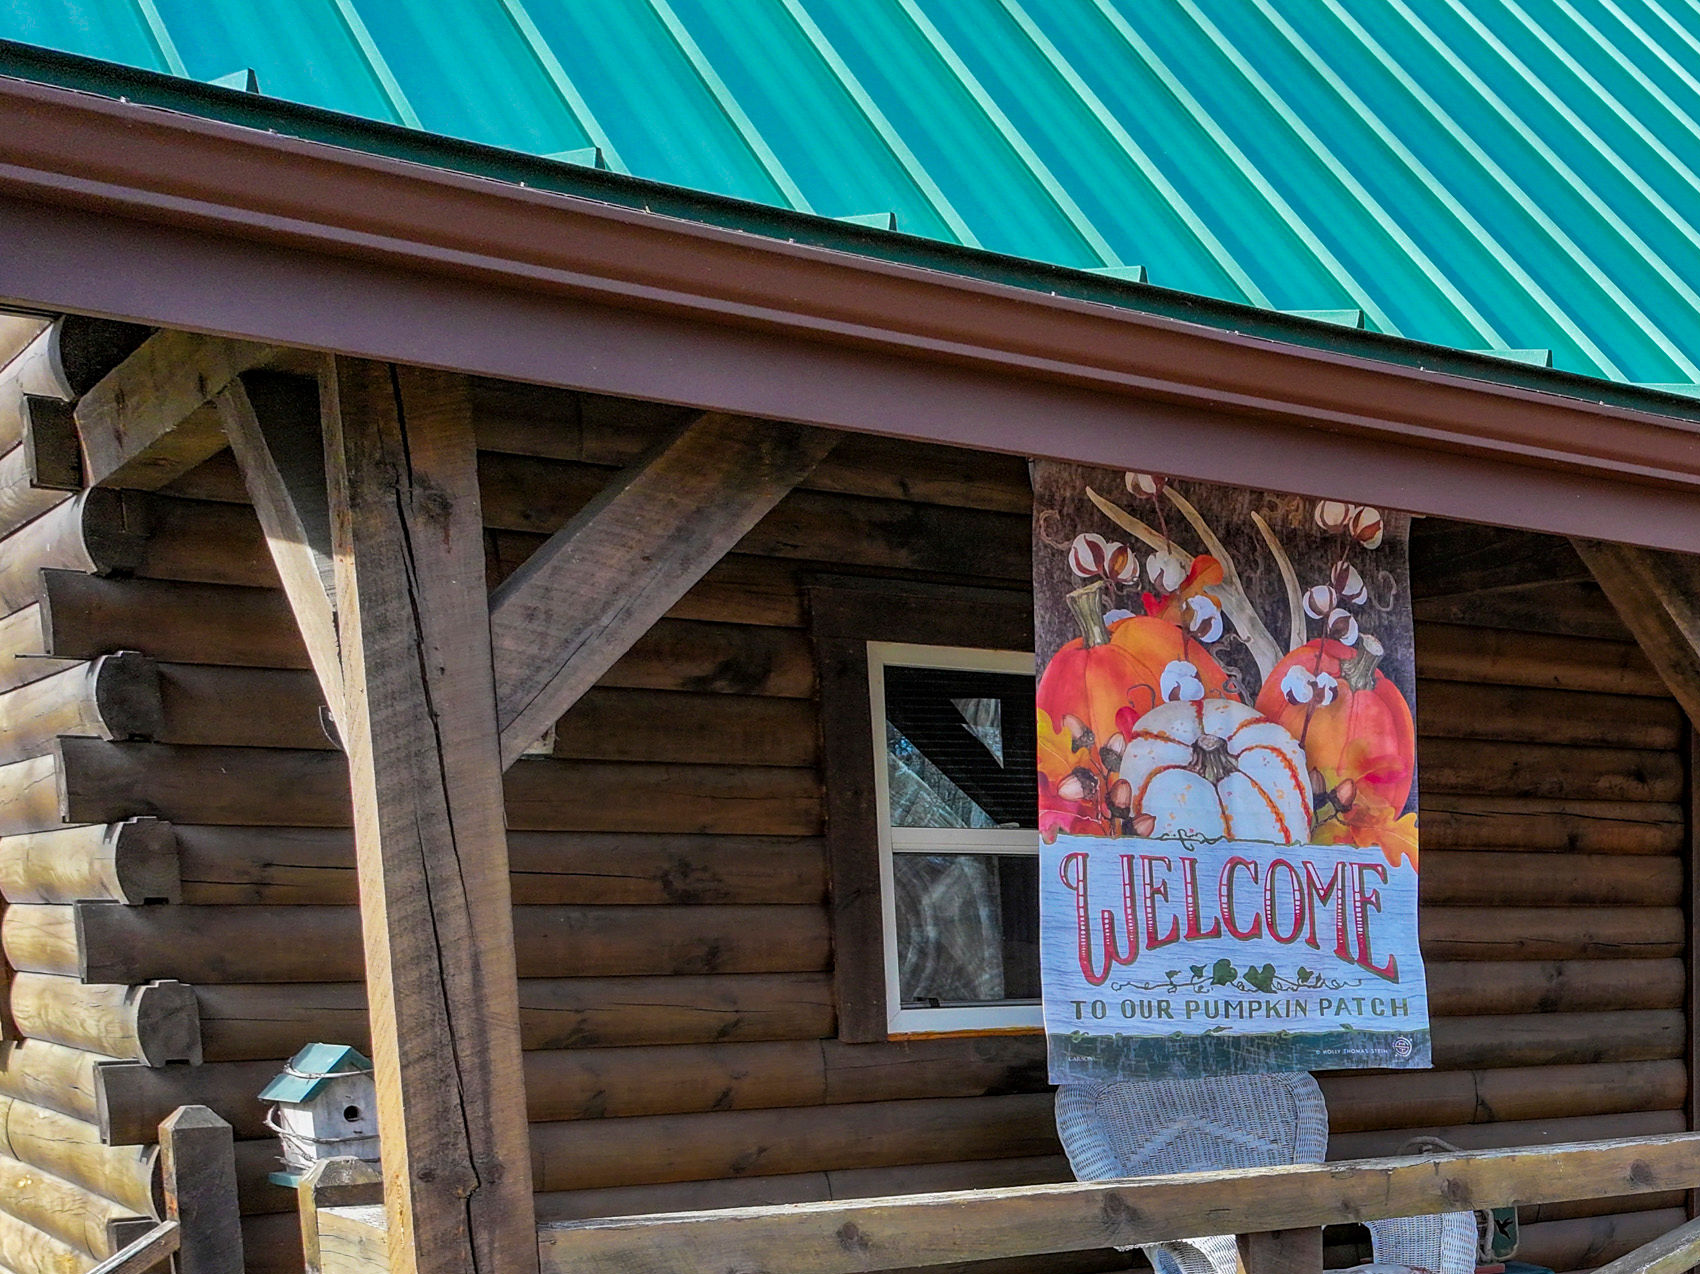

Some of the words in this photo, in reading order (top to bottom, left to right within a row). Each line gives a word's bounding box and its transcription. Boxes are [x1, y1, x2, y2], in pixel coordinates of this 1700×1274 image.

[1059, 852, 1399, 986] WELCOME
[1070, 999, 1107, 1020] TO
[1120, 999, 1174, 1020] OUR
[1185, 998, 1308, 1020] PUMPKIN
[1319, 997, 1410, 1017] PATCH
